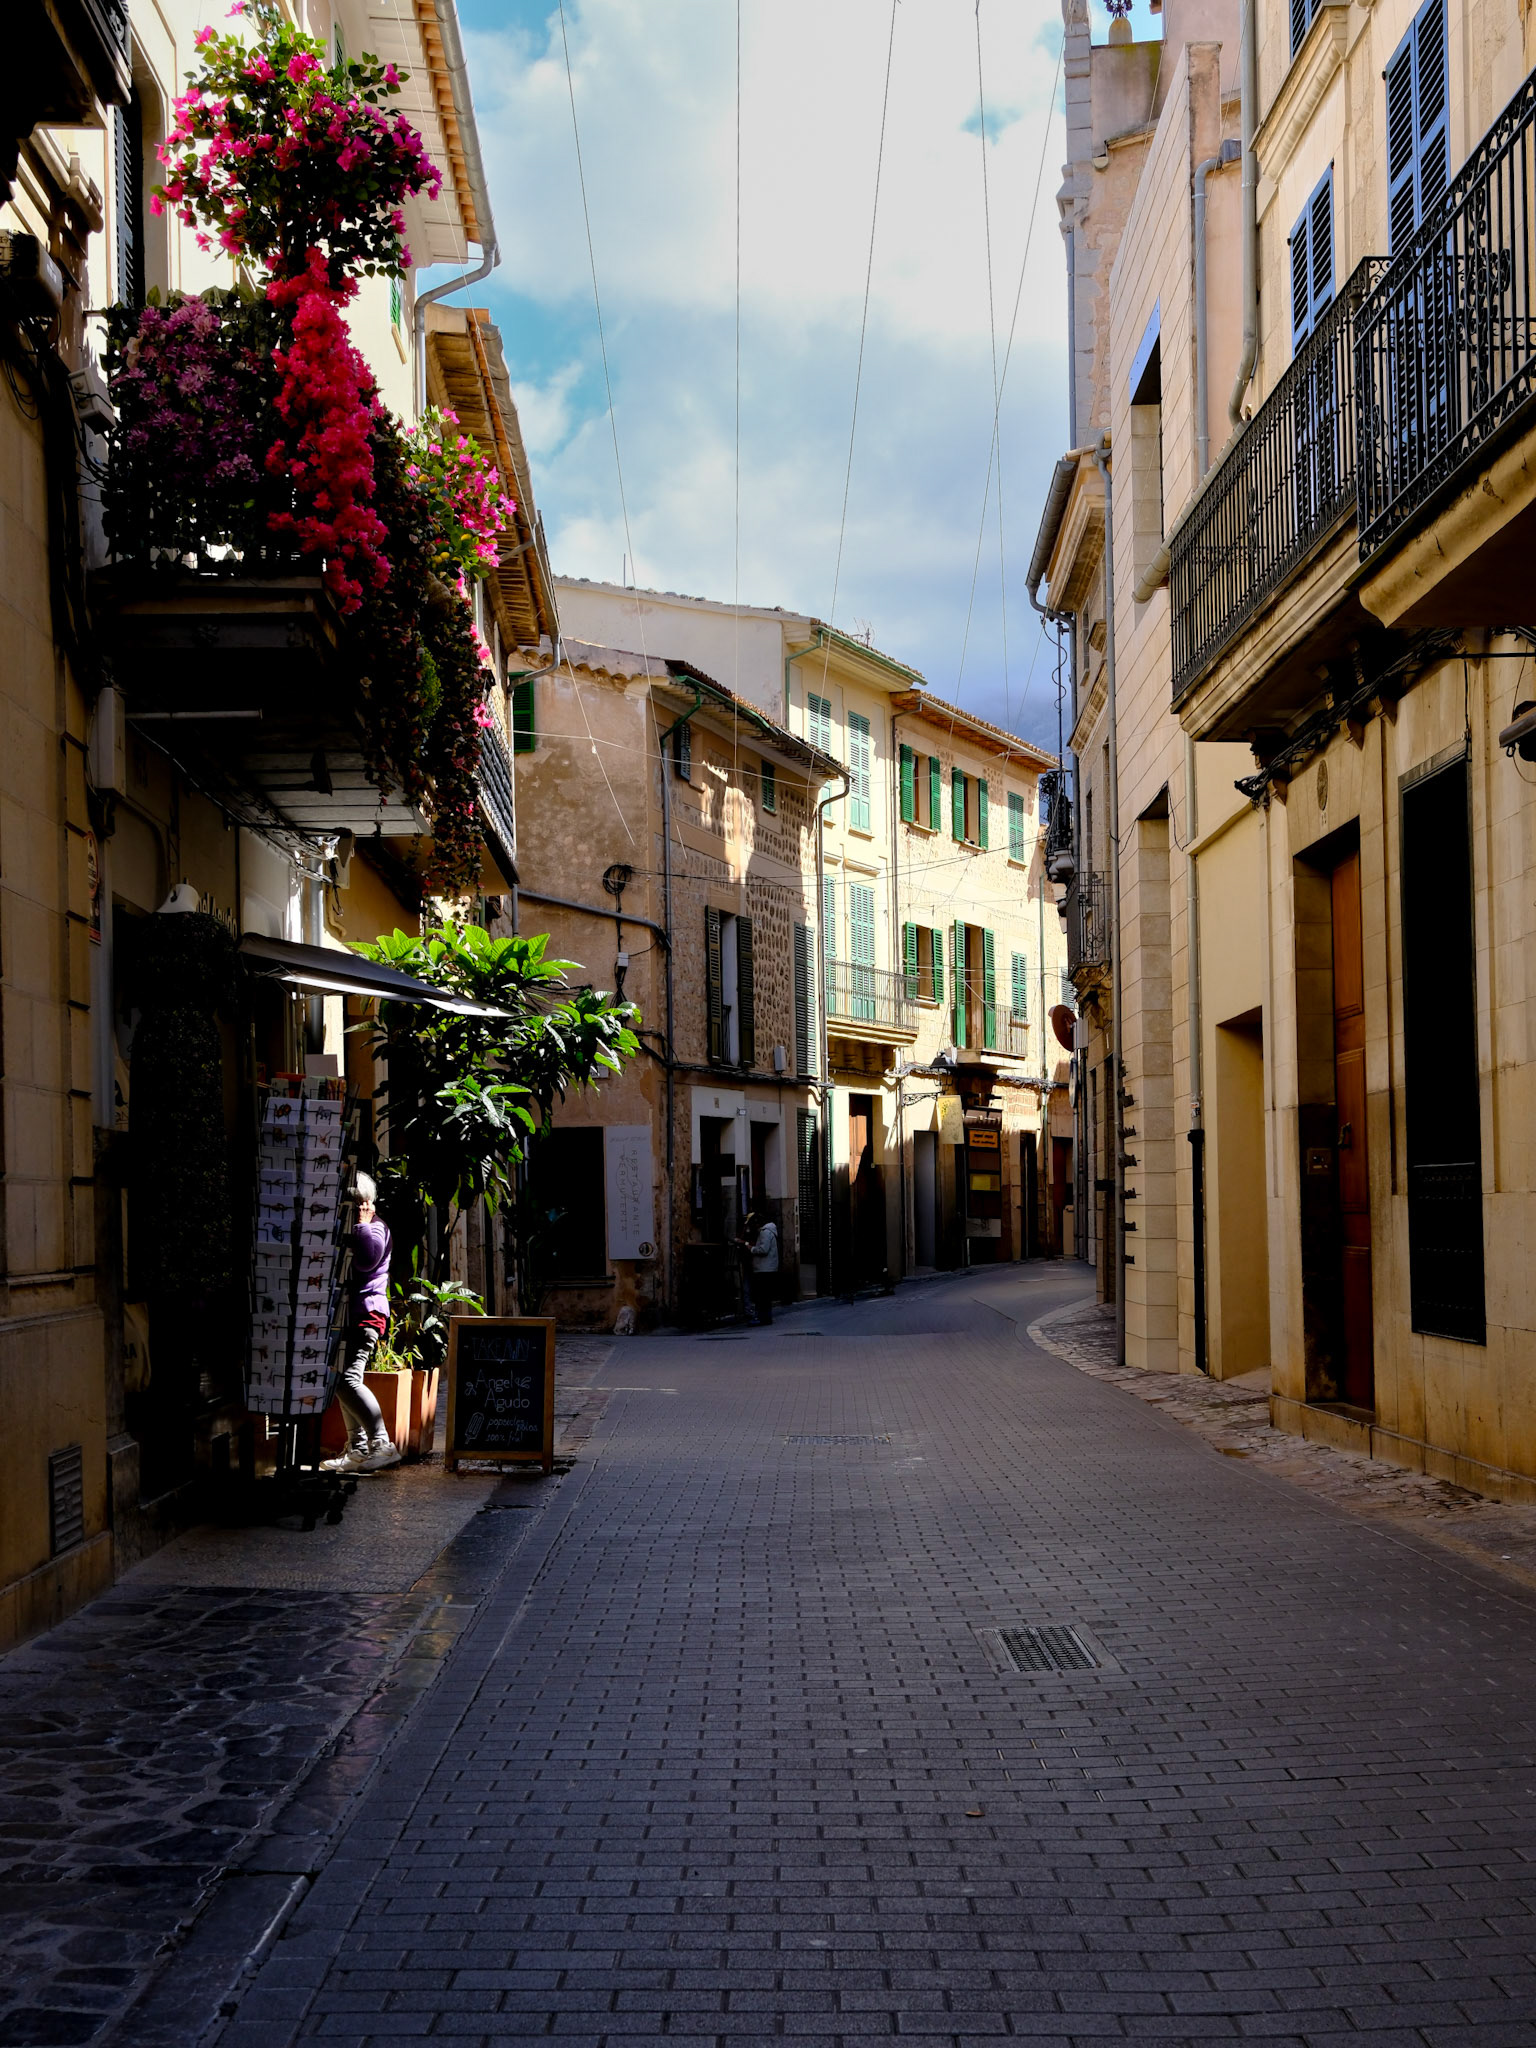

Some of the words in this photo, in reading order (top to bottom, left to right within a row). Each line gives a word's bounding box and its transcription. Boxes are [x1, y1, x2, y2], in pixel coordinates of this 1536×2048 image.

[630, 1150, 640, 1236] RESTAURANTE
[472, 1337, 502, 1359] TAKE
[476, 1369, 514, 1392] Angel
[484, 1388, 530, 1412] Agudo
